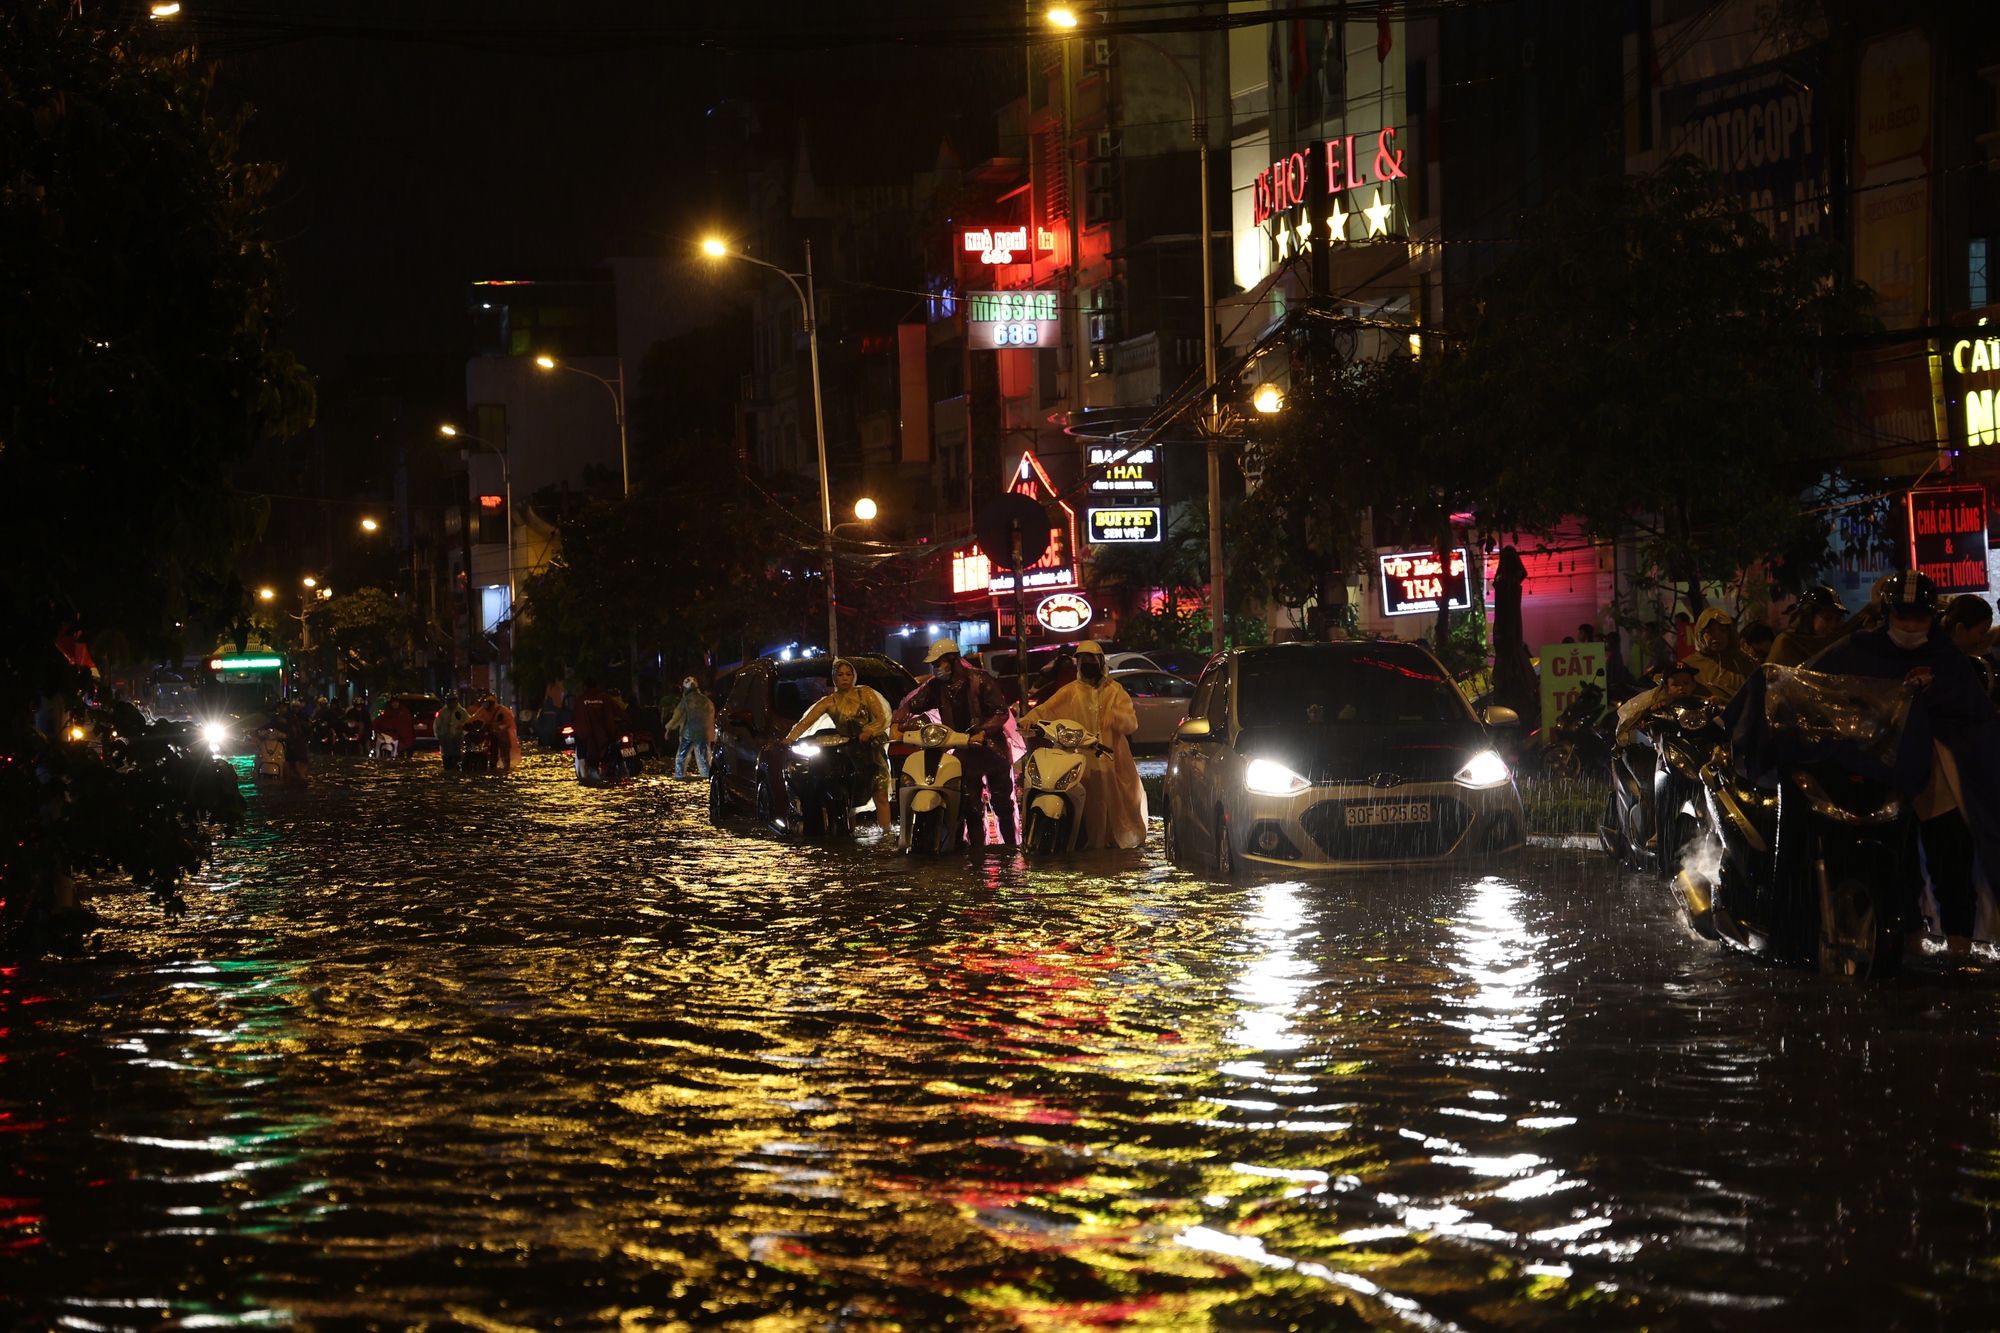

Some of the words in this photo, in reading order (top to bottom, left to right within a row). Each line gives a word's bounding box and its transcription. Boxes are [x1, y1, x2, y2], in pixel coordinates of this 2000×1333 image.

[1868, 103, 1921, 136] HABECO
[1670, 88, 1815, 175] PHOTOCOPY
[1272, 135, 1365, 213] HOEL
[1373, 126, 1408, 182] &
[965, 228, 993, 251] NHÀ
[981, 249, 1013, 264] 686
[971, 293, 1059, 322] MASSAGE
[993, 323, 1039, 346] 686
[1095, 511, 1154, 526] BUFFET
[1917, 500, 1937, 535] CHẢ
[1938, 503, 1953, 534] CÁ
[1954, 502, 1981, 533] LĂNG
[1103, 528, 1122, 539] SEN
[1123, 526, 1146, 541] VIỆT
[1945, 538, 1954, 555] &
[1384, 557, 1412, 577] VIP
[1412, 555, 1465, 577] Masge
[1953, 554, 1986, 587] NƯỚNG
[1401, 577, 1443, 599] THA
[1010, 626, 1031, 635] 66
[1050, 610, 1079, 628] 686
[1552, 648, 1595, 676] CẮT
[1553, 686, 1580, 711] TÓ
